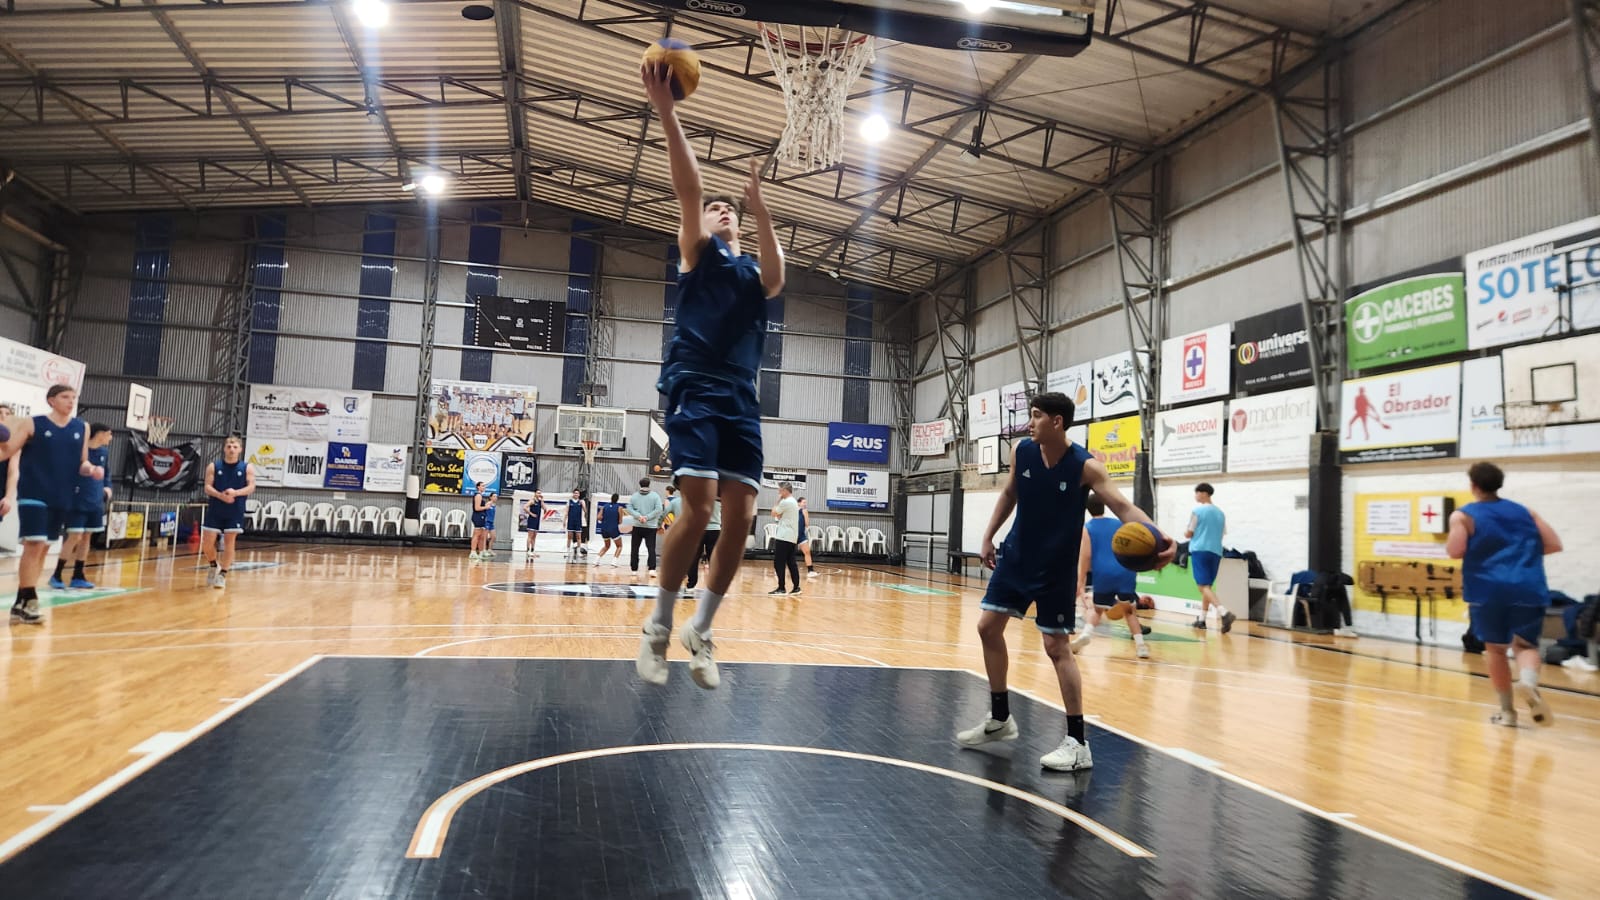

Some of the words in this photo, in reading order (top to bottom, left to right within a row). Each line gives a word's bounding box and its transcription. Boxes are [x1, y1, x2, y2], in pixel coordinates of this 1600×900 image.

[1382, 284, 1455, 323] CACERES
[1389, 383, 1400, 397] El
[1249, 396, 1311, 425] monfort
[1383, 395, 1451, 413] Obrador
[1471, 405, 1488, 417] LA
[1177, 418, 1217, 435] INFOCOM
[853, 436, 883, 449] RUS
